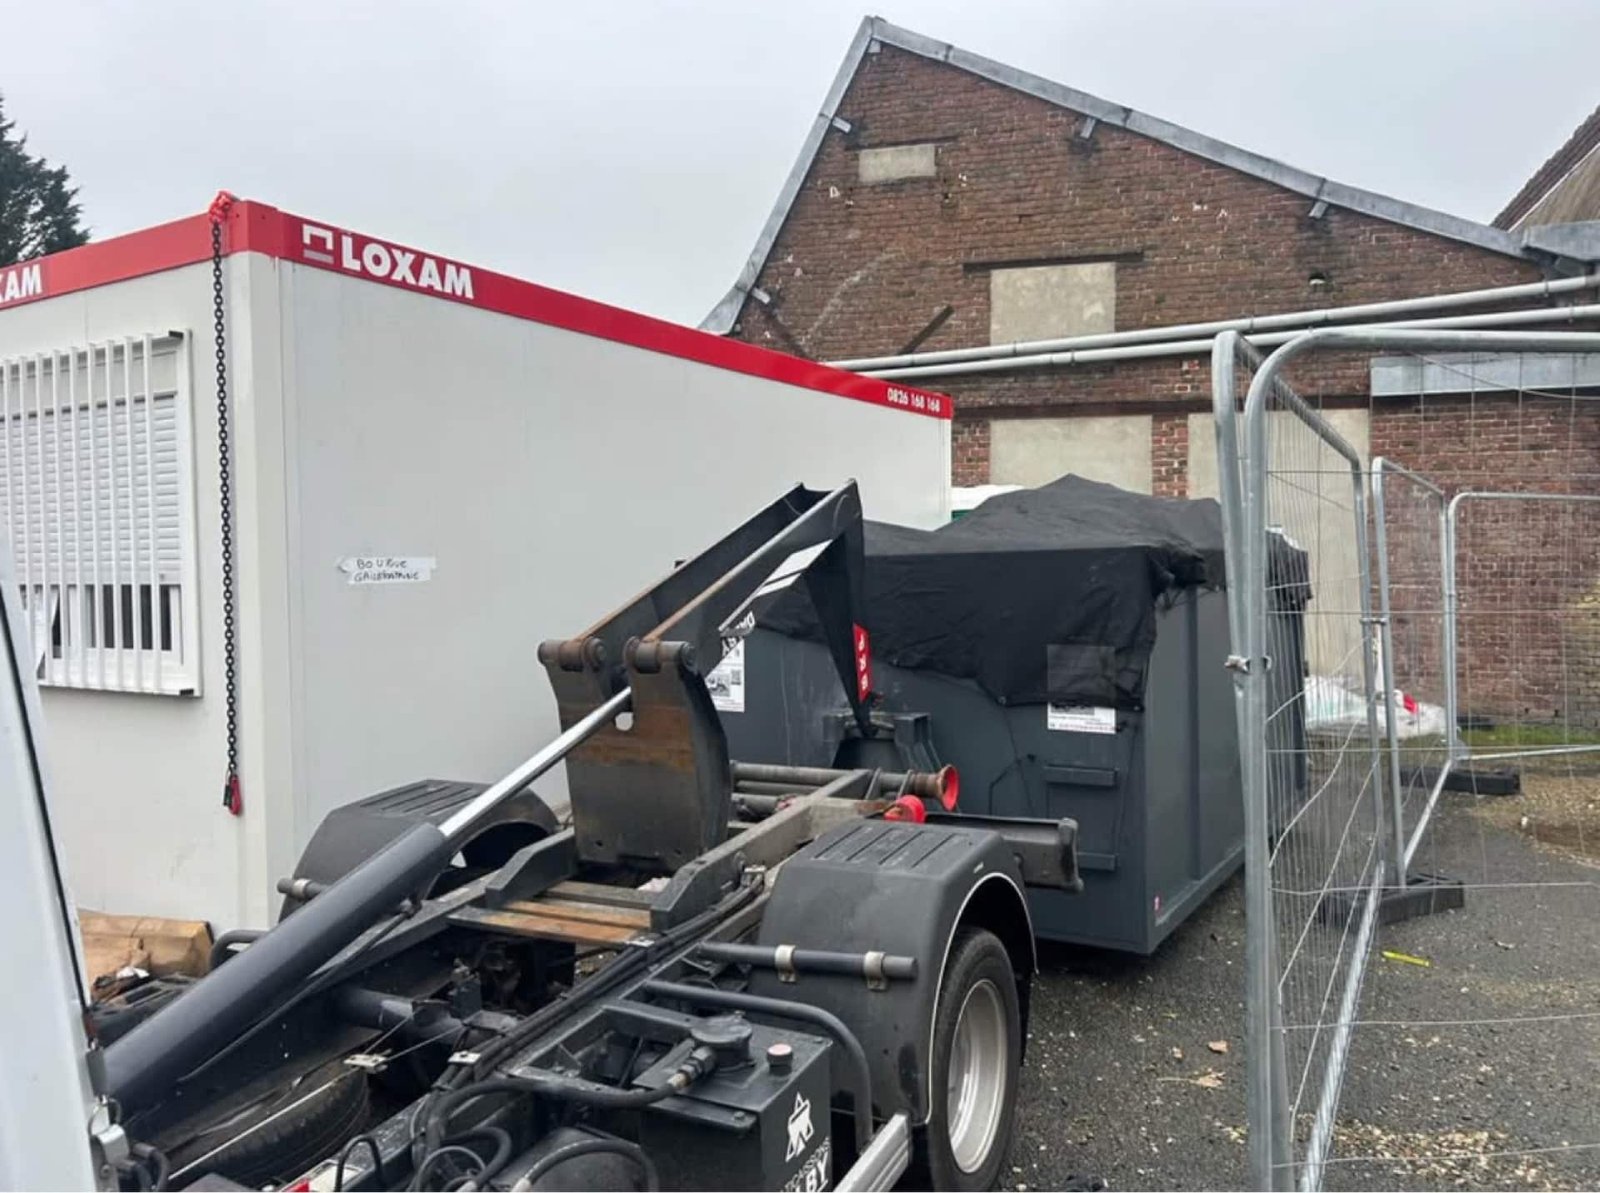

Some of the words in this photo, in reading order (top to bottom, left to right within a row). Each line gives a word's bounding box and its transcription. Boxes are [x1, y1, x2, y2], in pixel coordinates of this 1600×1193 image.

[0, 264, 42, 303] AM
[341, 234, 474, 300] LOXAM
[796, 1151, 829, 1192] BY
